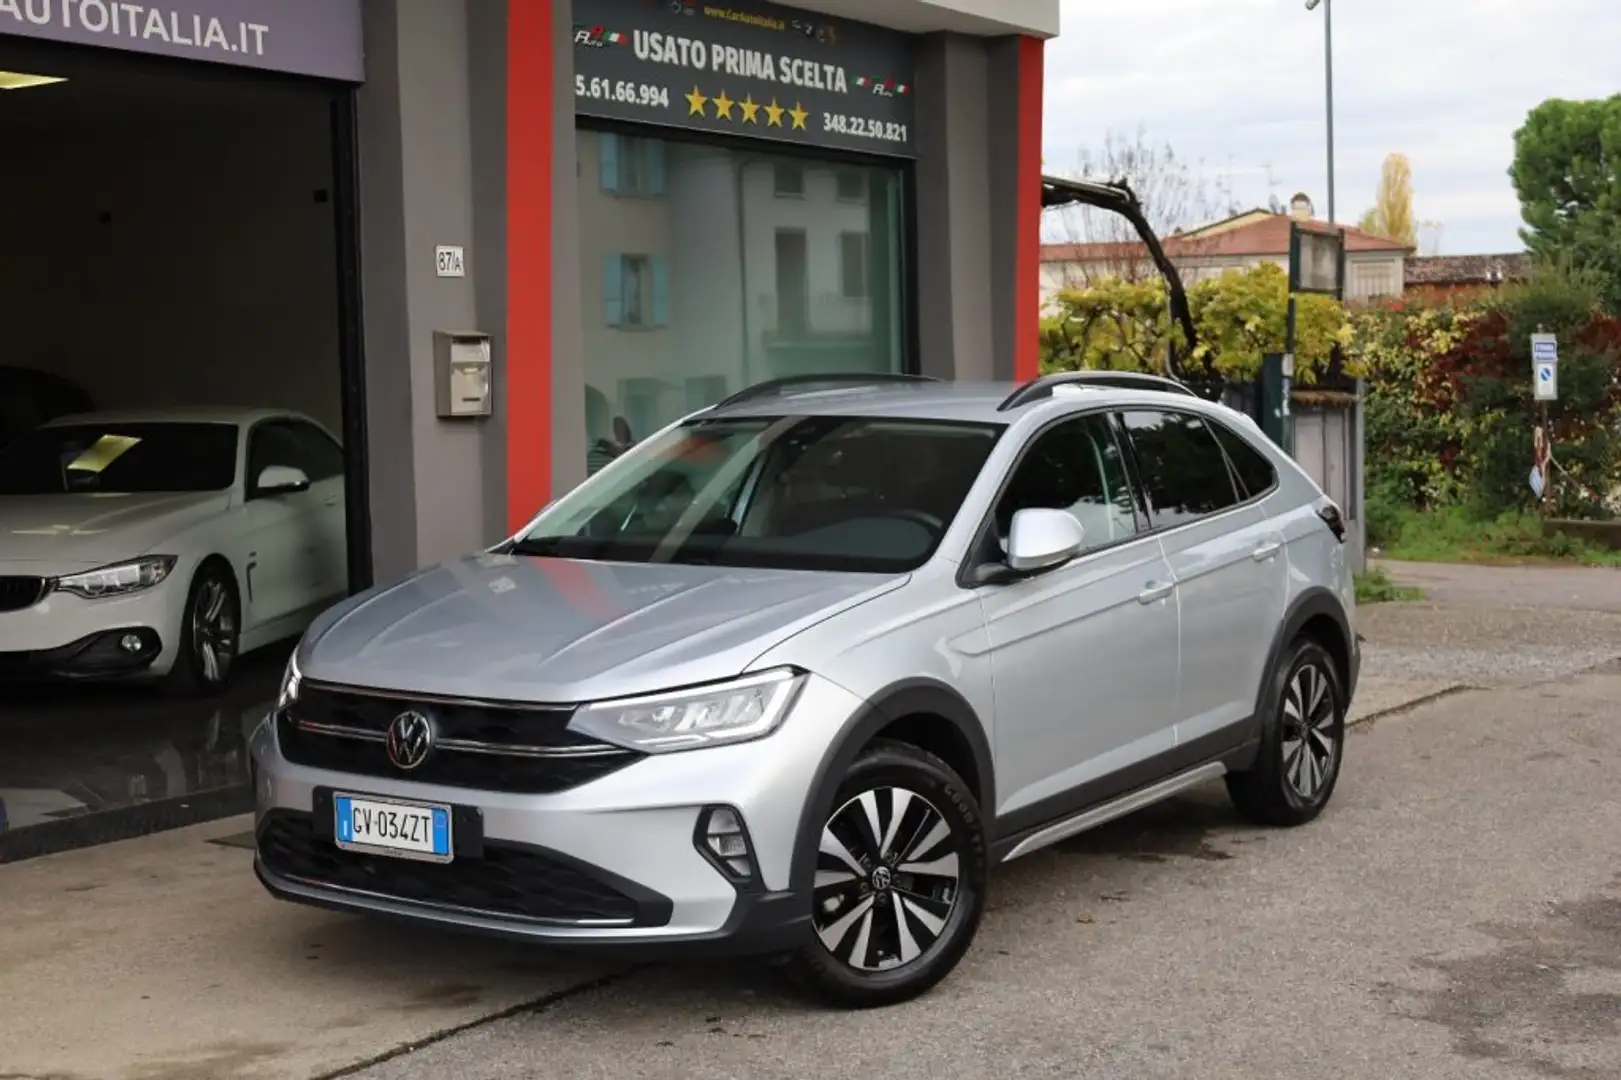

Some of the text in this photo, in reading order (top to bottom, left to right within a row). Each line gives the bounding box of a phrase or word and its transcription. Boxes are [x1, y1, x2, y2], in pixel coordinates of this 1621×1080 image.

[632, 29, 848, 94] USATO PRIMA SCELTA
[575, 74, 669, 109] 5.61.66.994
[822, 112, 907, 142] 348.22.50.821
[437, 251, 462, 271] 87/A
